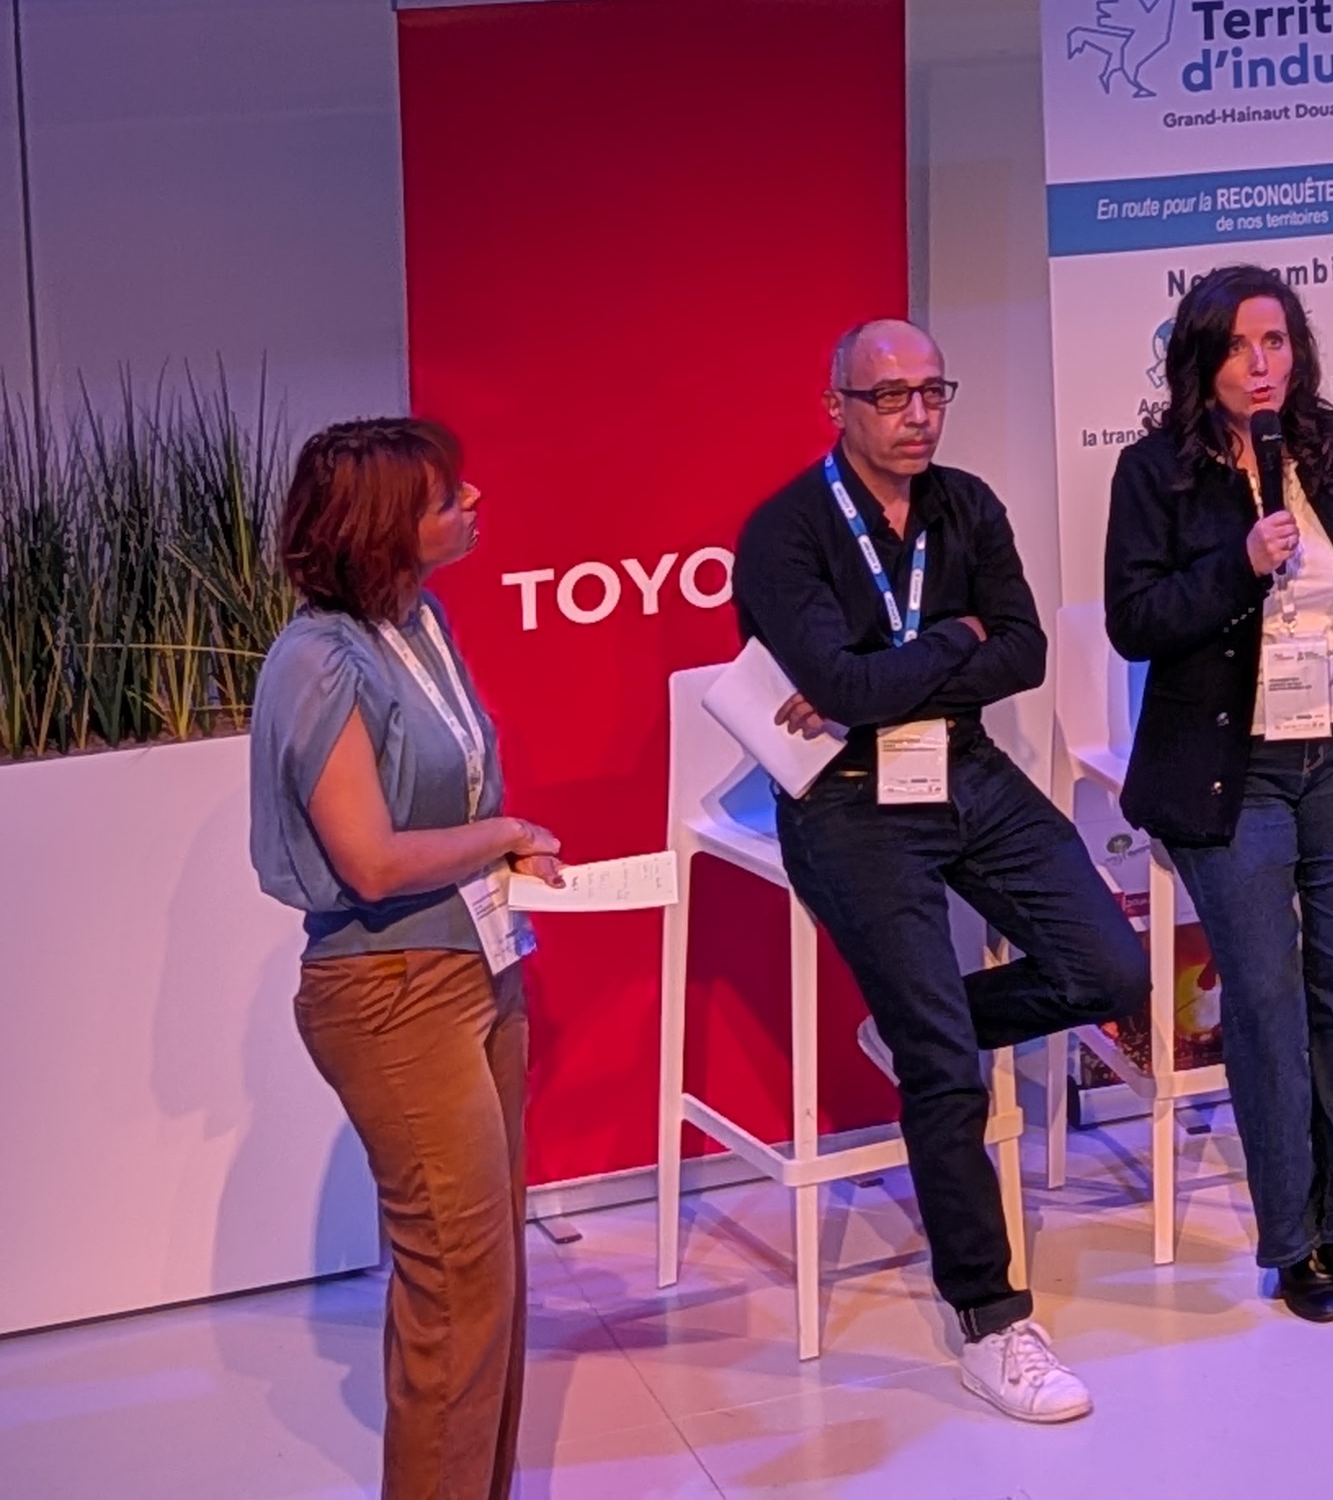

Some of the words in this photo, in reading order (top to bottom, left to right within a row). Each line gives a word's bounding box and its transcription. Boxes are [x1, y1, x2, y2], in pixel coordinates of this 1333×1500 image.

[1162, 104, 1291, 130] Grand-Hainaut
[1096, 199, 1118, 220] En
[1121, 199, 1161, 218] route
[1162, 197, 1197, 220] pour
[1198, 192, 1212, 212] la
[1215, 214, 1234, 231] de
[1236, 214, 1264, 230] nos
[1265, 208, 1330, 228] territoires
[1082, 429, 1097, 446] la
[1102, 428, 1147, 446] trans
[501, 546, 736, 630] TOYO
